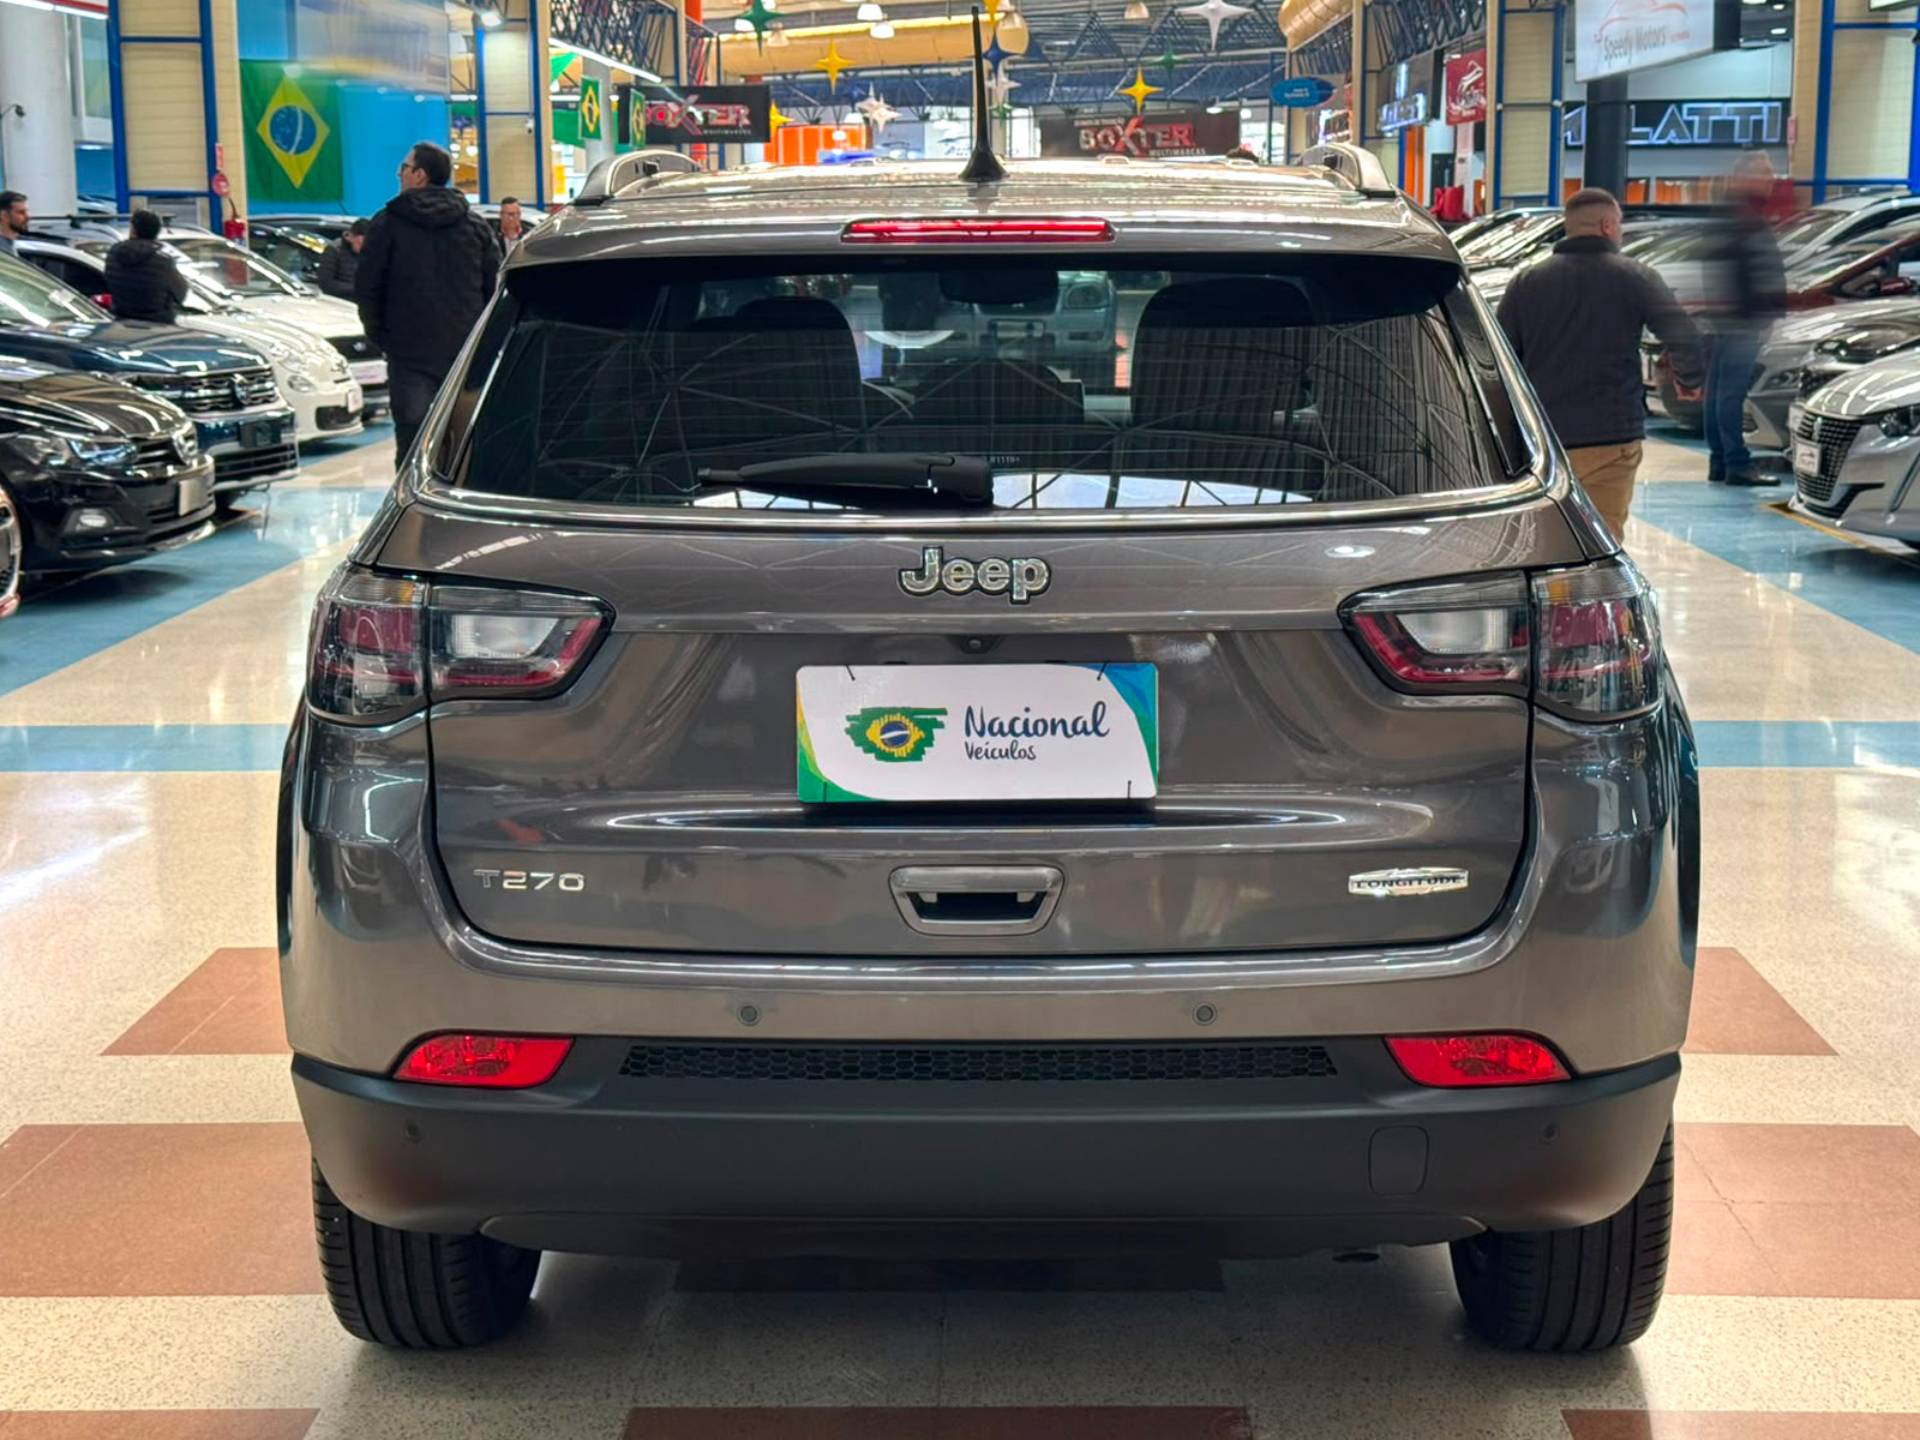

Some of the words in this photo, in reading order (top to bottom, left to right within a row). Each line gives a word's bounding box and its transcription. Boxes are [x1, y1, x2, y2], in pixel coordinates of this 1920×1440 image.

[1603, 30, 1633, 67] Speedy
[1078, 115, 1196, 157] BOXTER
[899, 546, 1051, 604] Jeep
[964, 701, 1110, 738] Nacional
[473, 869, 585, 891] T270
